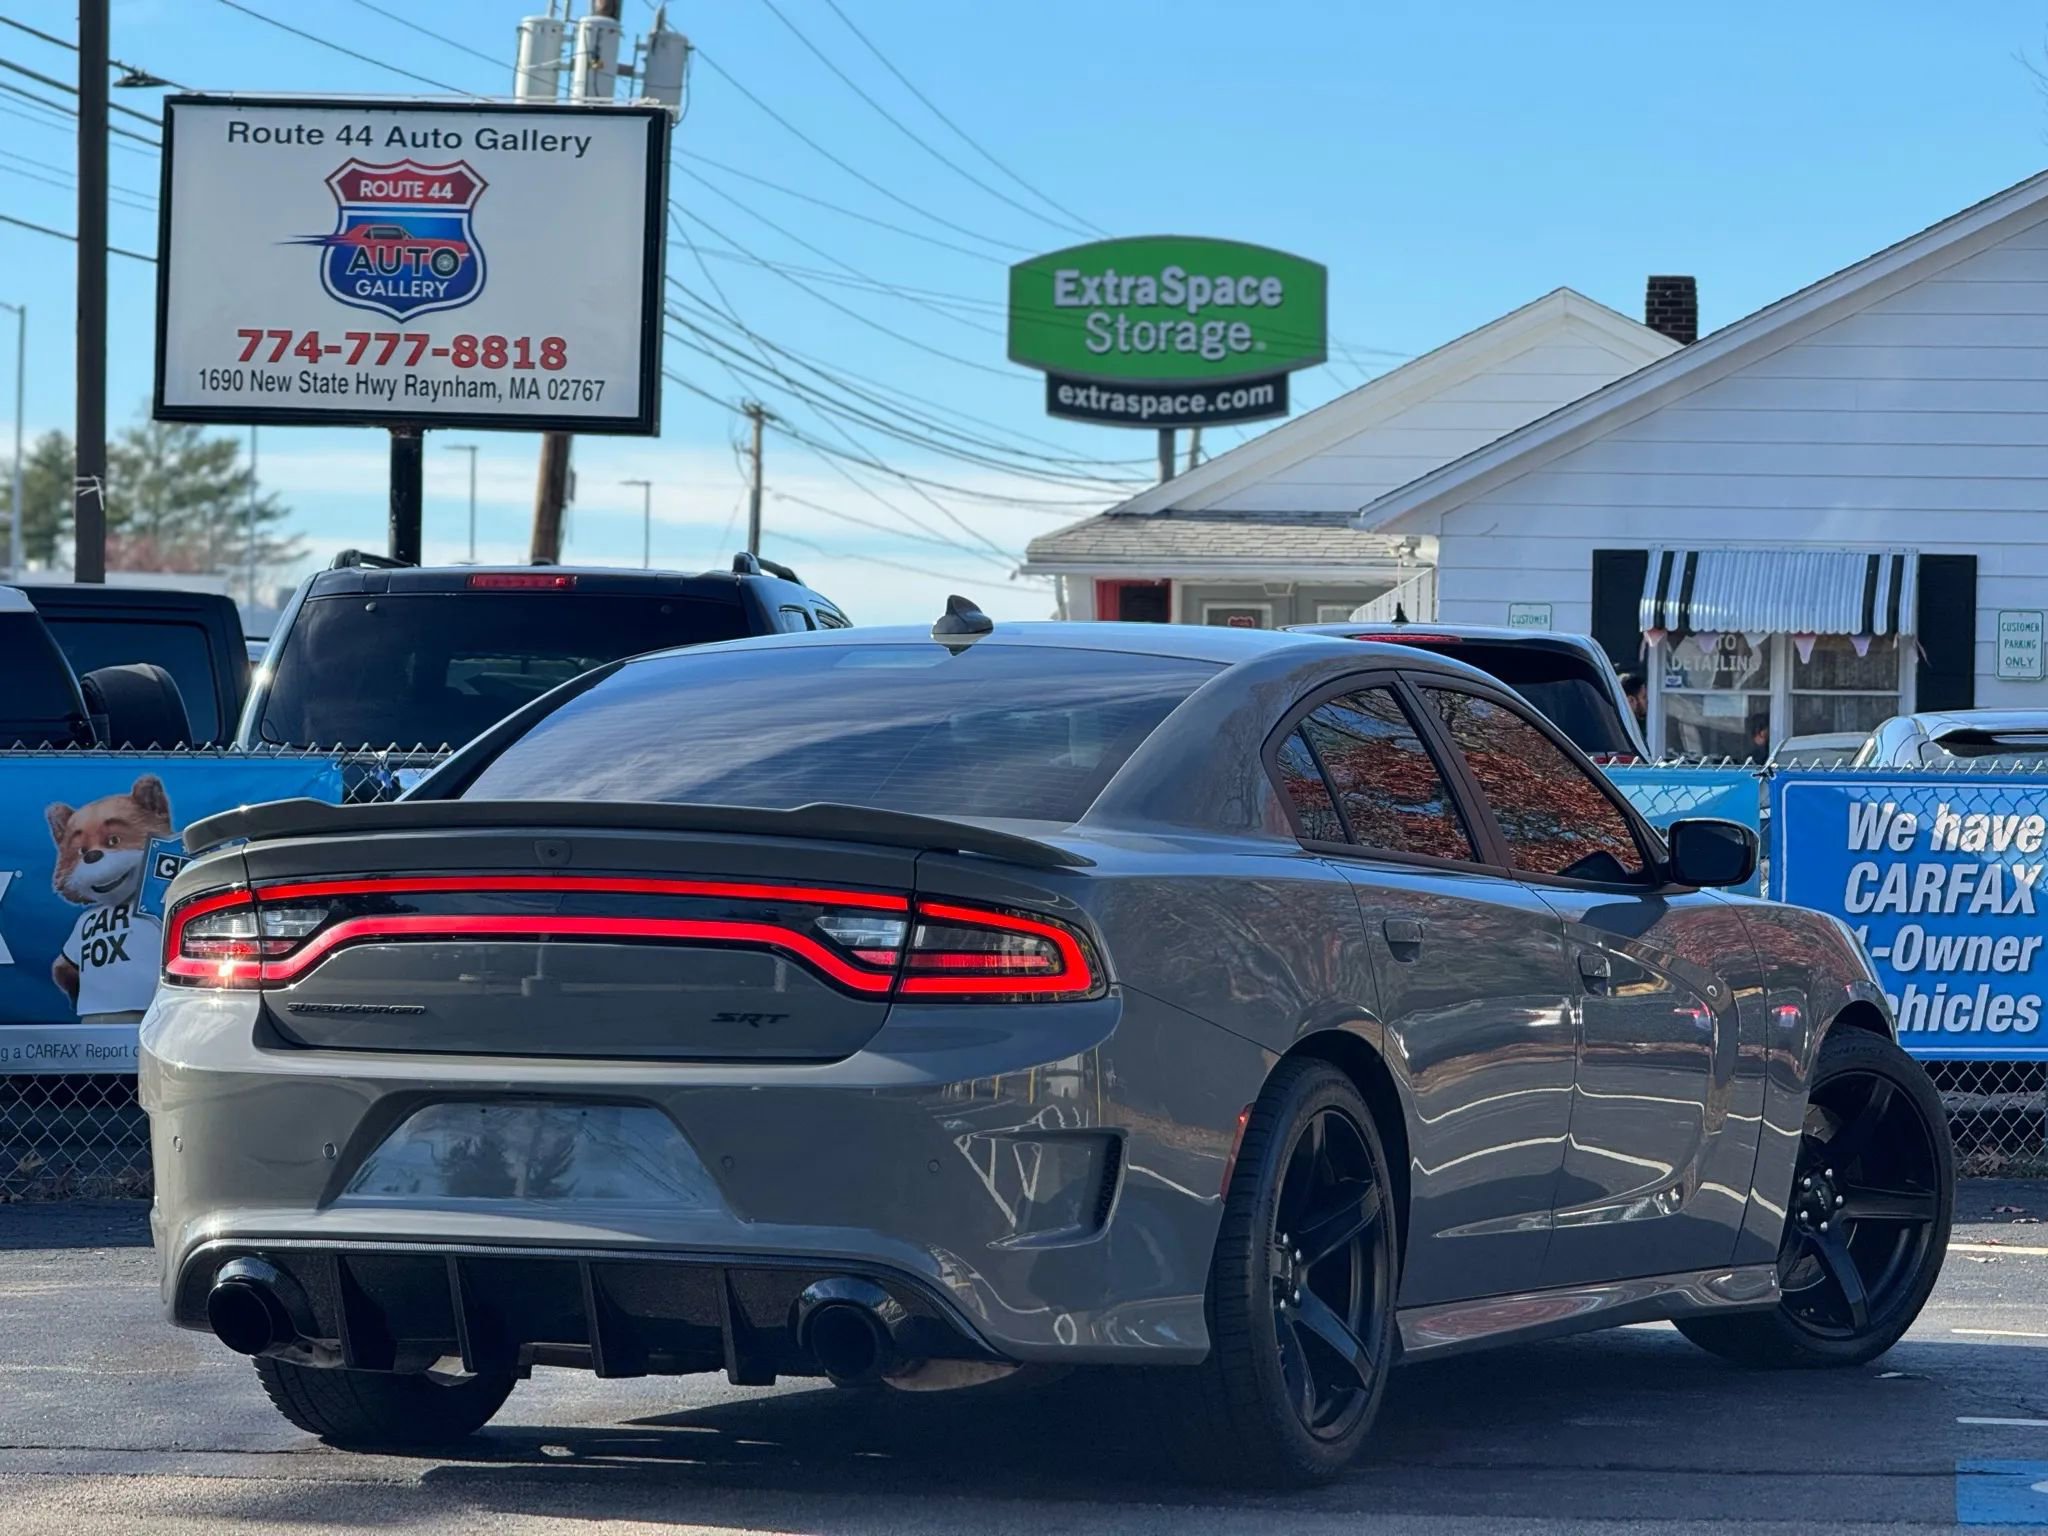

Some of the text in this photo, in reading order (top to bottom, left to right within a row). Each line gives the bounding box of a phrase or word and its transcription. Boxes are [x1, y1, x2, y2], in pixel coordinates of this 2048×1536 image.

[228, 121, 592, 158] Route 44 Auto Gallery
[360, 180, 454, 199] ROUTE 44
[346, 246, 461, 279] AUTO
[355, 280, 450, 298] GALLERY
[237, 329, 568, 371] 774-777-8818
[1085, 312, 1254, 361] Storage
[199, 368, 605, 403] 1690 New State Hwy Raynham, MA 02767
[1058, 383, 1275, 418] extraspace.com
[1511, 614, 1549, 625] CUSTOMER
[2001, 622, 2040, 633] CUSTOMER
[2004, 638, 2037, 649] PARKING
[2005, 656, 2034, 669] ONLY
[1847, 802, 2046, 853] We have
[1844, 861, 2042, 915] CARFAX
[82, 904, 130, 941] CAR
[81, 932, 131, 972] FOX
[710, 1012, 790, 1028] SRT
[1886, 983, 2041, 1033] hicles
[13, 1047, 21, 1059] a
[86, 1043, 129, 1060] Report
